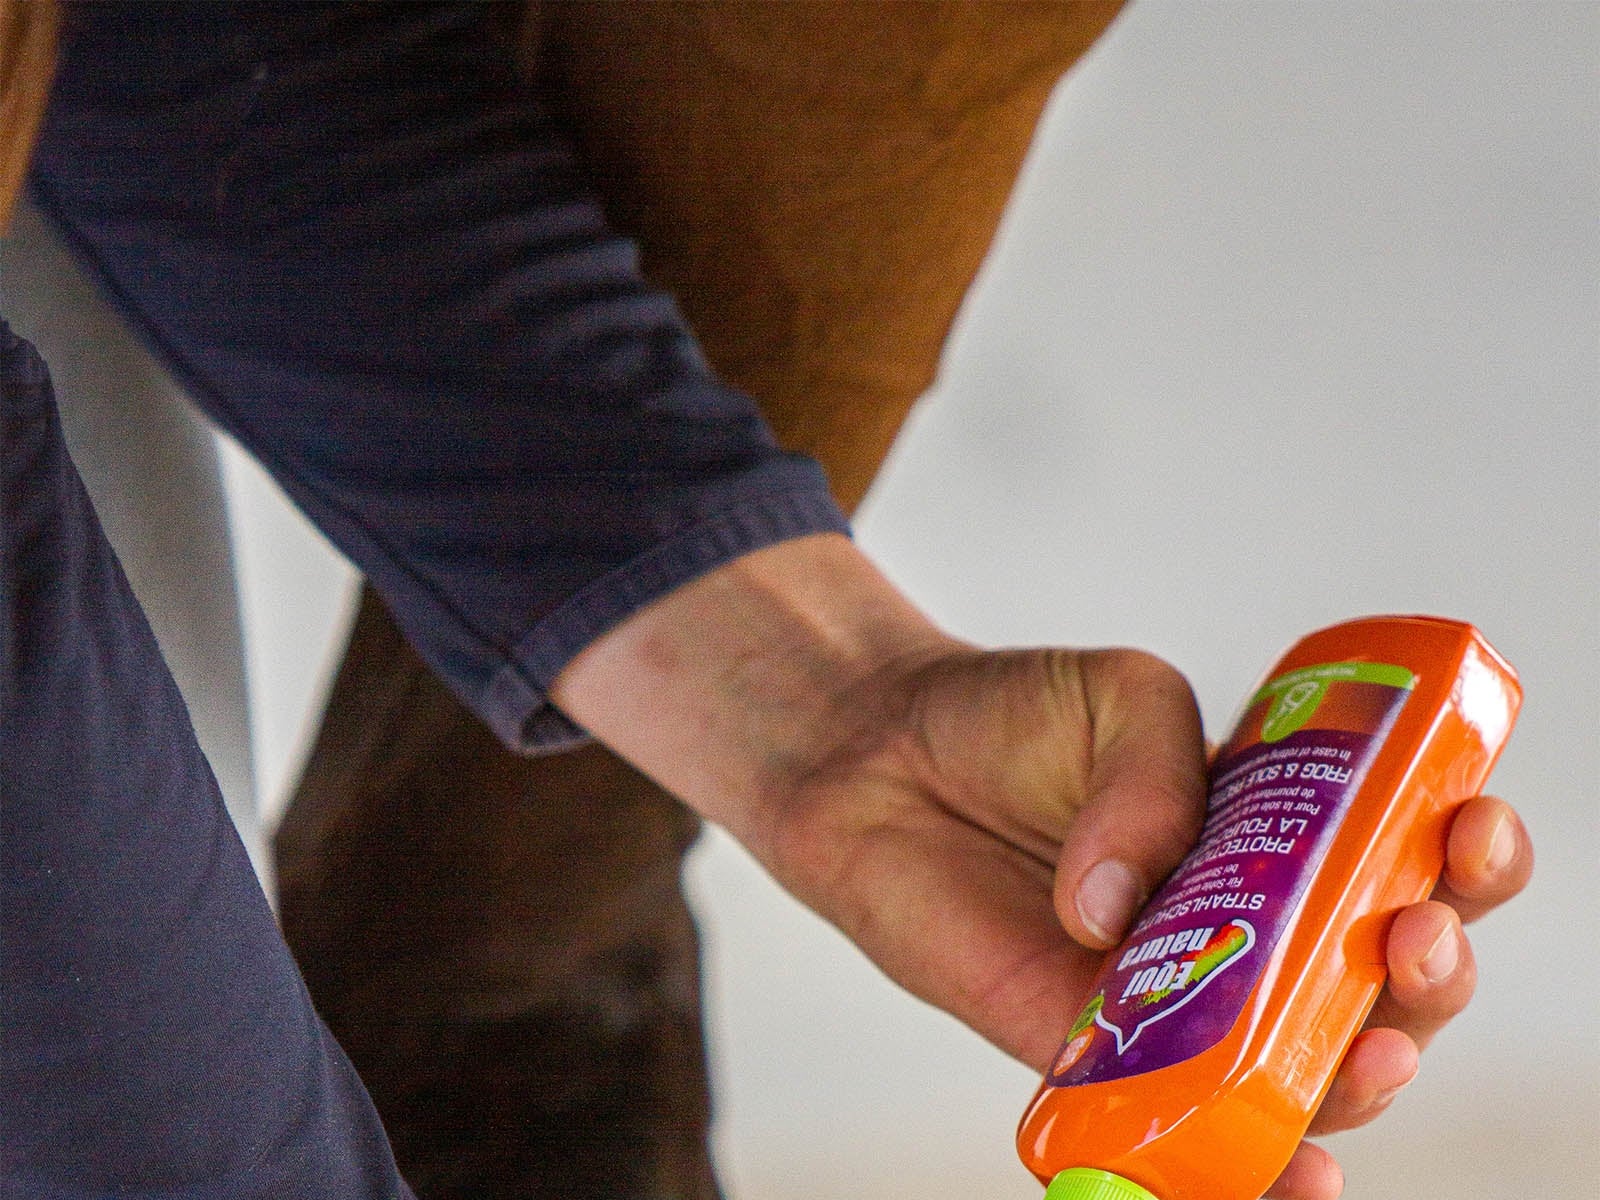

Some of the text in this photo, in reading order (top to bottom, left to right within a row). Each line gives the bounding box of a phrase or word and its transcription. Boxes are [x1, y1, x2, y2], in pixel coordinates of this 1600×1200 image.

[1311, 747, 1337, 757] case
[1338, 750, 1350, 761] In
[1243, 764, 1281, 787] SOLE
[1283, 762, 1297, 778] &
[1299, 762, 1352, 782] FROG
[1300, 788, 1314, 798] de
[1282, 801, 1292, 811] la
[1294, 801, 1320, 814] Pour
[1278, 817, 1307, 834] LA
[1116, 927, 1213, 970] natura
